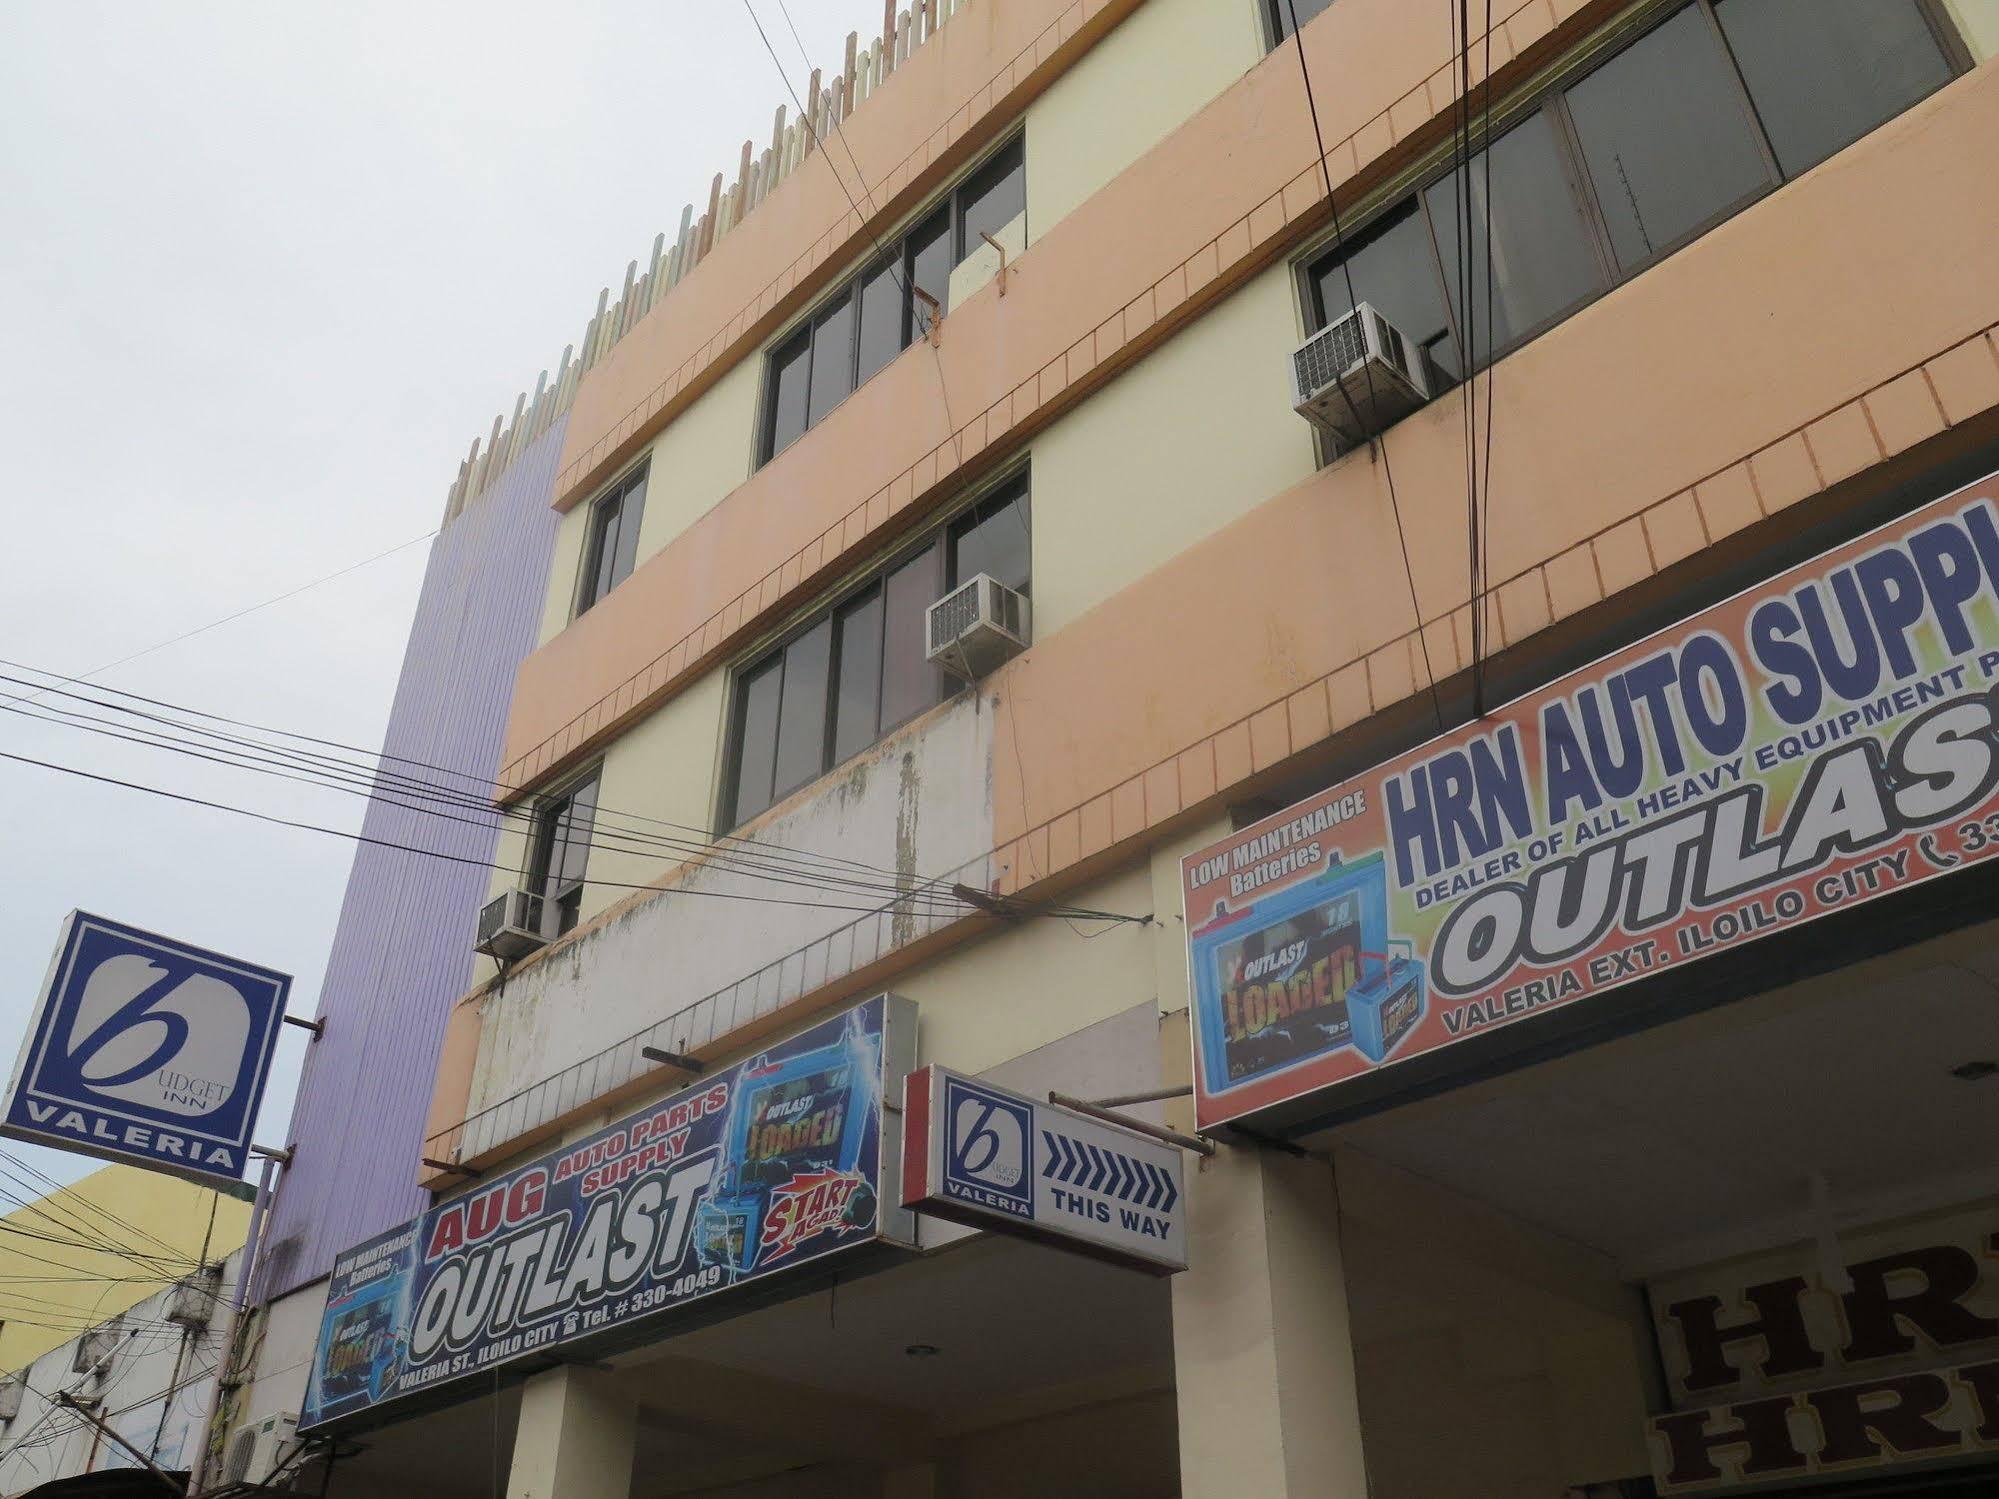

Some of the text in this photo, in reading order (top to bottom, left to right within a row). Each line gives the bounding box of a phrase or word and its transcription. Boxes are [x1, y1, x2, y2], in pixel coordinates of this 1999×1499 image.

[1385, 725, 1533, 888] HRN
[1544, 636, 1747, 825] AUTO
[1416, 852, 1521, 909] DEALER
[1528, 832, 1562, 862] OF
[1575, 809, 1629, 844] ALL
[1636, 758, 1743, 818] HEAVY
[1754, 665, 1965, 770] EQUIPMENT
[1190, 789, 1367, 889] LOW MAINTENANCE
[1230, 842, 1321, 897] Batteries
[1244, 939, 1306, 981] OUTLAST
[1442, 969, 1583, 1034] VALERIA
[1590, 941, 1670, 985] EXT.
[1677, 891, 1804, 955] ILOILO
[1815, 849, 1910, 904] CITY
[163, 1091, 207, 1110] INN
[767, 1094, 814, 1119] OUTLAST
[25, 1100, 234, 1169] VALERIA
[582, 1129, 691, 1195] SUPPLY
[427, 1084, 728, 1260] AUG AUTO PARTS
[948, 1182, 1030, 1216] VALERIA
[762, 1178, 859, 1245] START
[791, 1207, 844, 1240] AGAD!
[1050, 1188, 1171, 1240] THIS WAY
[335, 1230, 417, 1280] LOW MAINTENANCE
[350, 1258, 393, 1288] Batteries
[412, 1154, 717, 1357] OUTLAST
[400, 1358, 449, 1390] VALERIA
[477, 1337, 522, 1364] ILOILO
[524, 1321, 560, 1347] CITY
[581, 1308, 611, 1330] Tel.
[614, 1302, 628, 1317] #
[631, 1265, 721, 1311] 330-4049
[1667, 1233, 1999, 1391] HR
